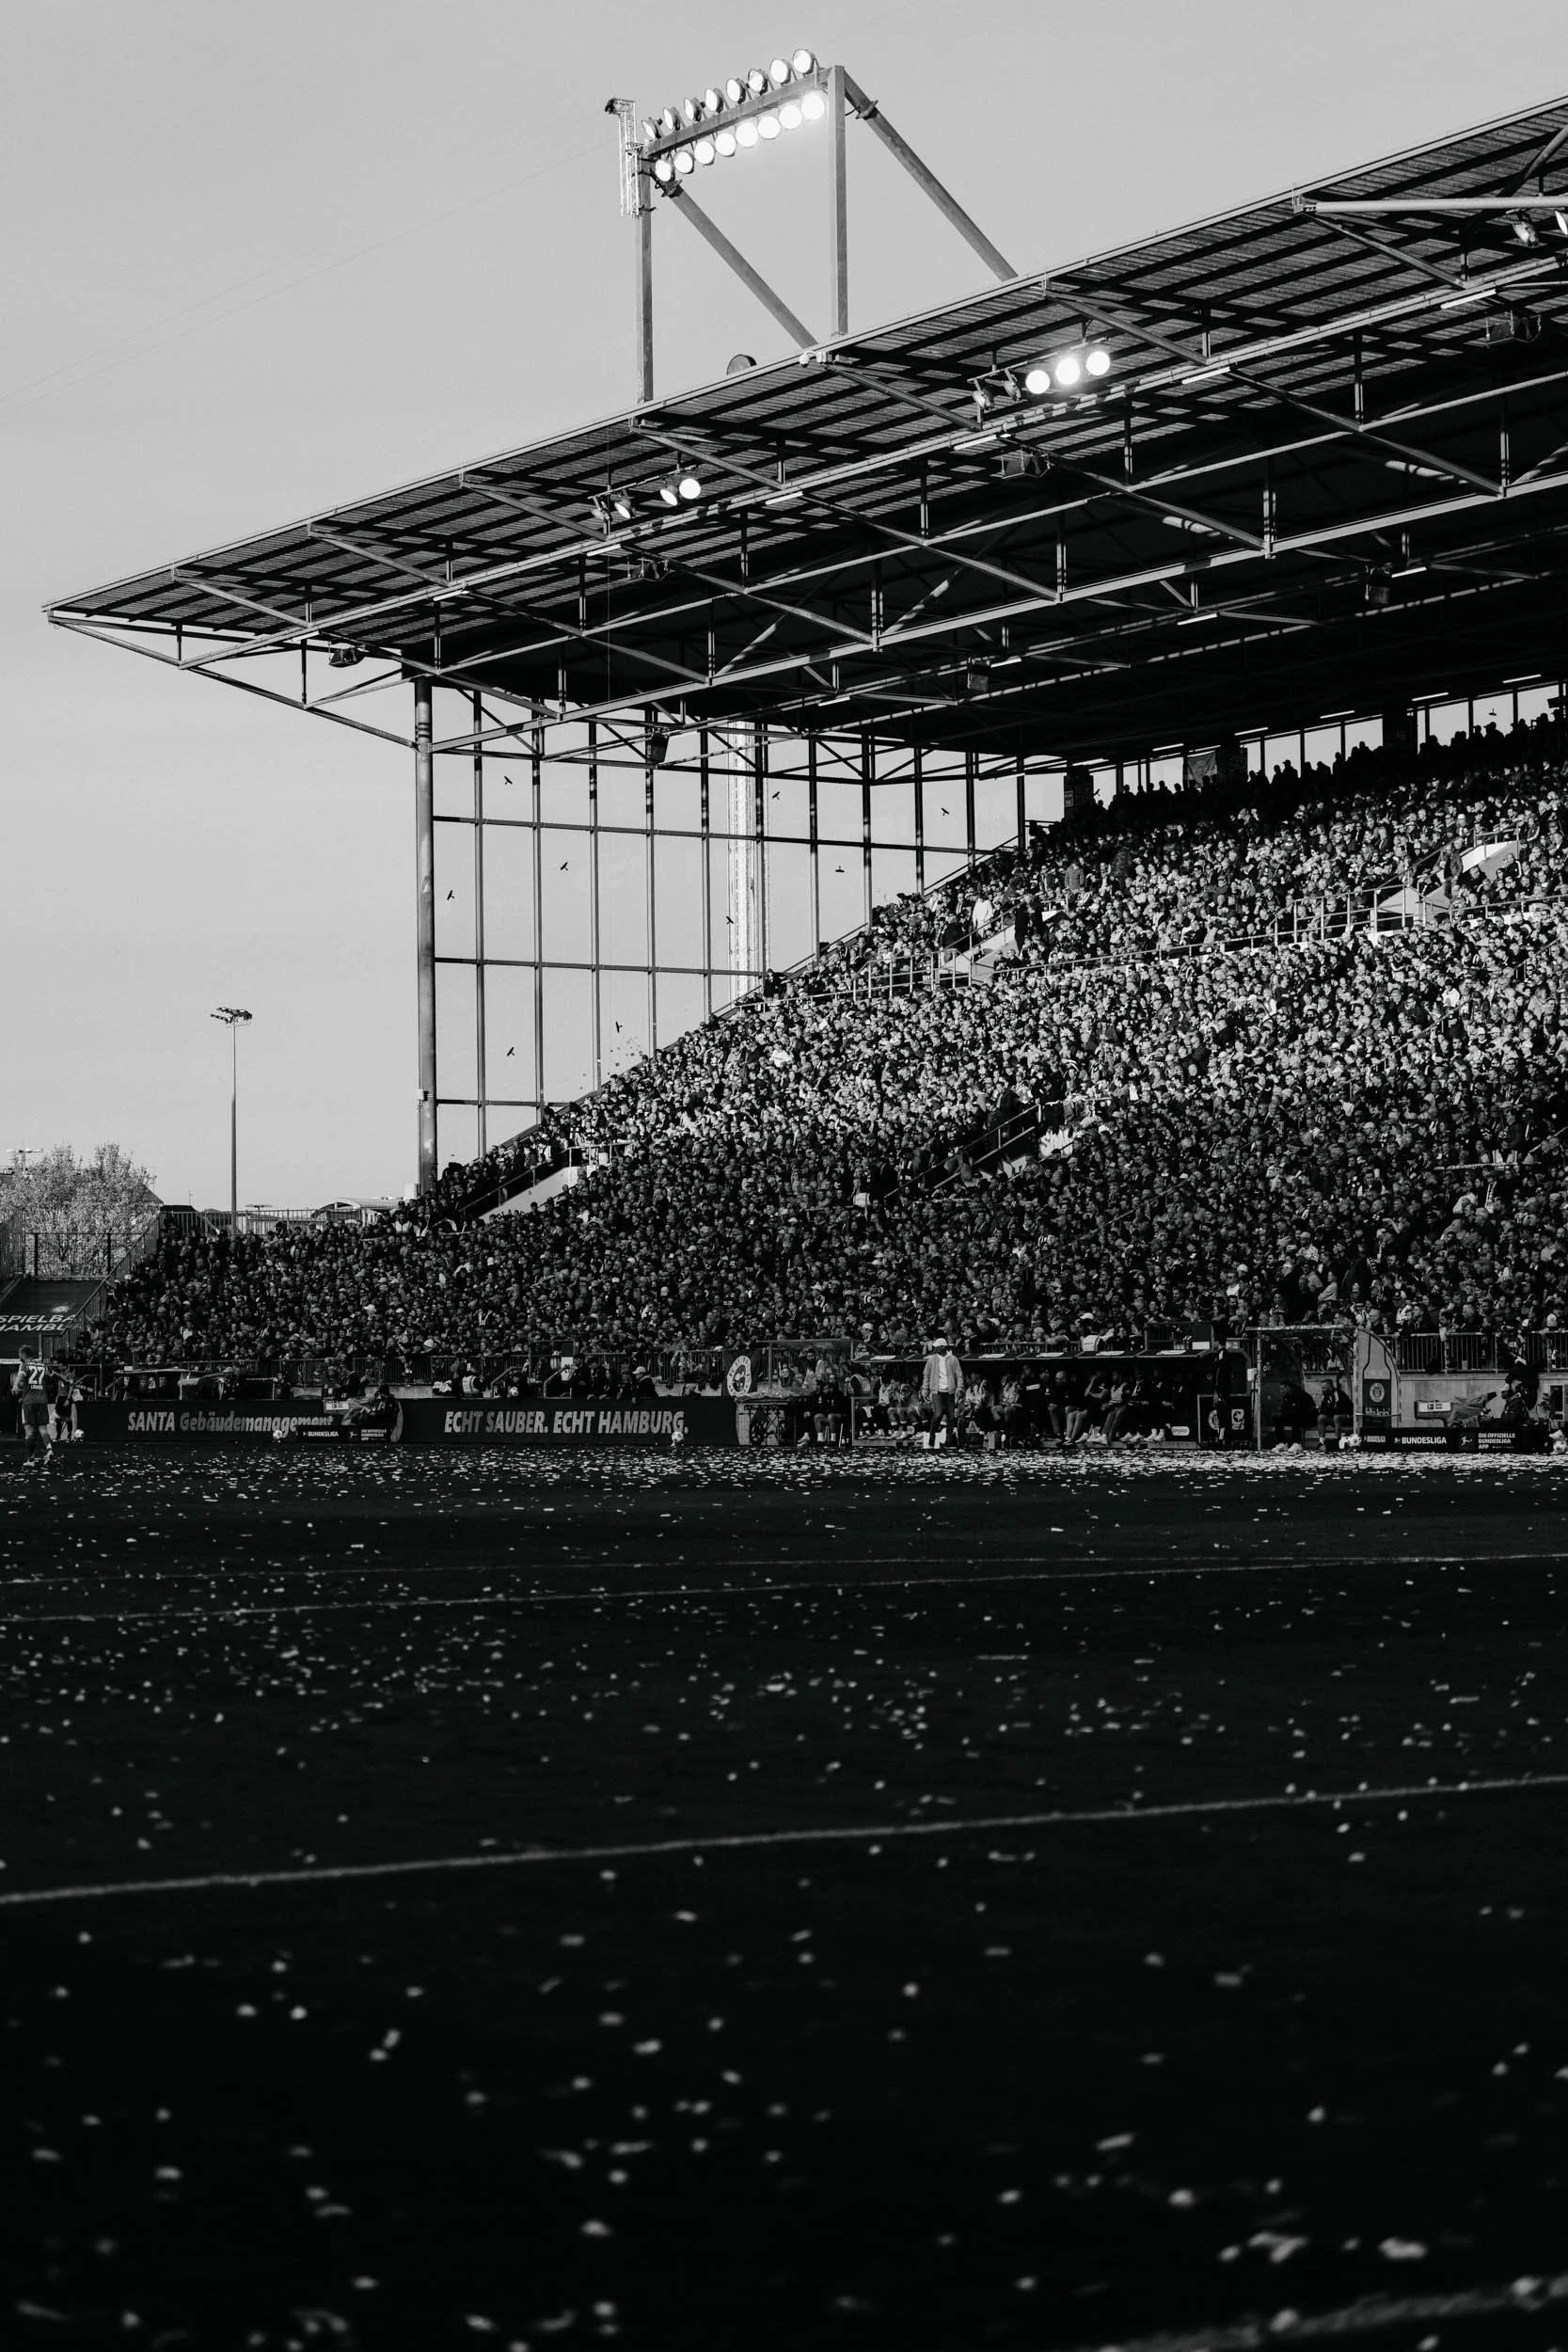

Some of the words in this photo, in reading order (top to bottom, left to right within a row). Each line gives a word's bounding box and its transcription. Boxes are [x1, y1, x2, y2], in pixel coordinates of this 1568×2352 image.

[28, 1365, 45, 1384] 27
[128, 1411, 175, 1431] SANTA
[444, 1410, 483, 1433] ECHT
[485, 1410, 548, 1433] SAUBER.
[552, 1410, 595, 1433] ECHT
[597, 1410, 689, 1434] HAMBURG.
[1401, 1436, 1447, 1444] BUNDESLIGA
